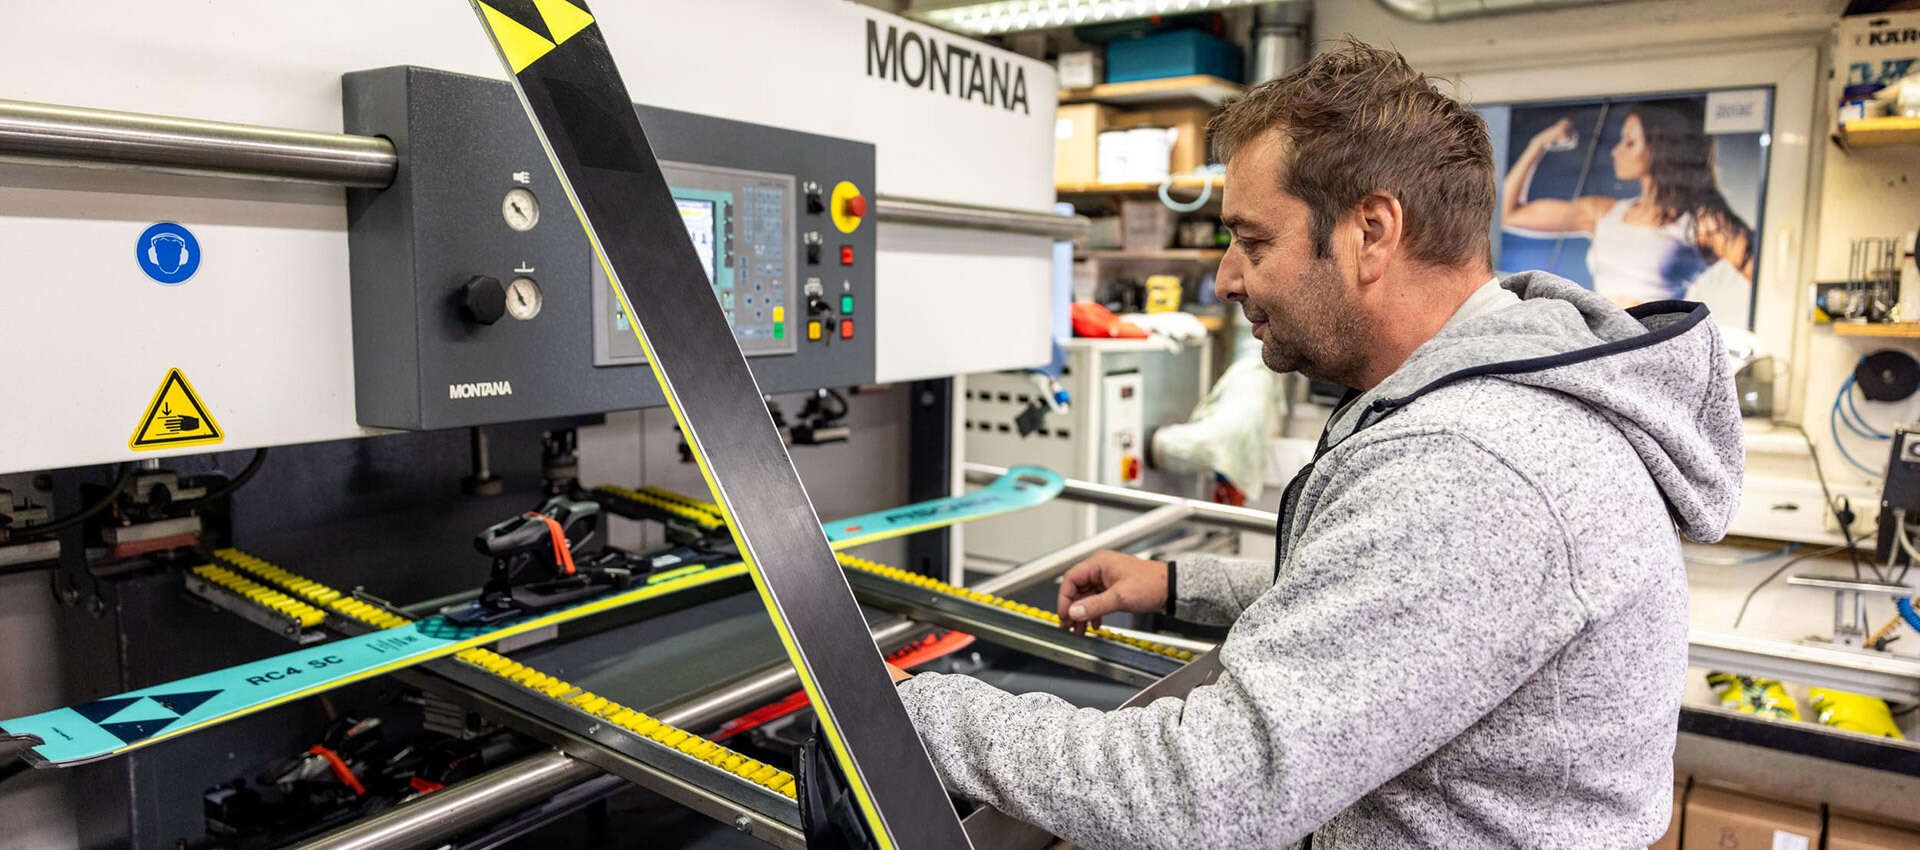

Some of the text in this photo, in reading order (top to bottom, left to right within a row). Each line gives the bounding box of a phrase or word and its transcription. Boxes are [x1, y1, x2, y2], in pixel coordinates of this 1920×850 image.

[1869, 28, 1920, 46] KÄR
[866, 18, 1030, 115] MONTANA
[449, 380, 513, 399] MONTANA
[245, 655, 343, 686] RC4 SC
